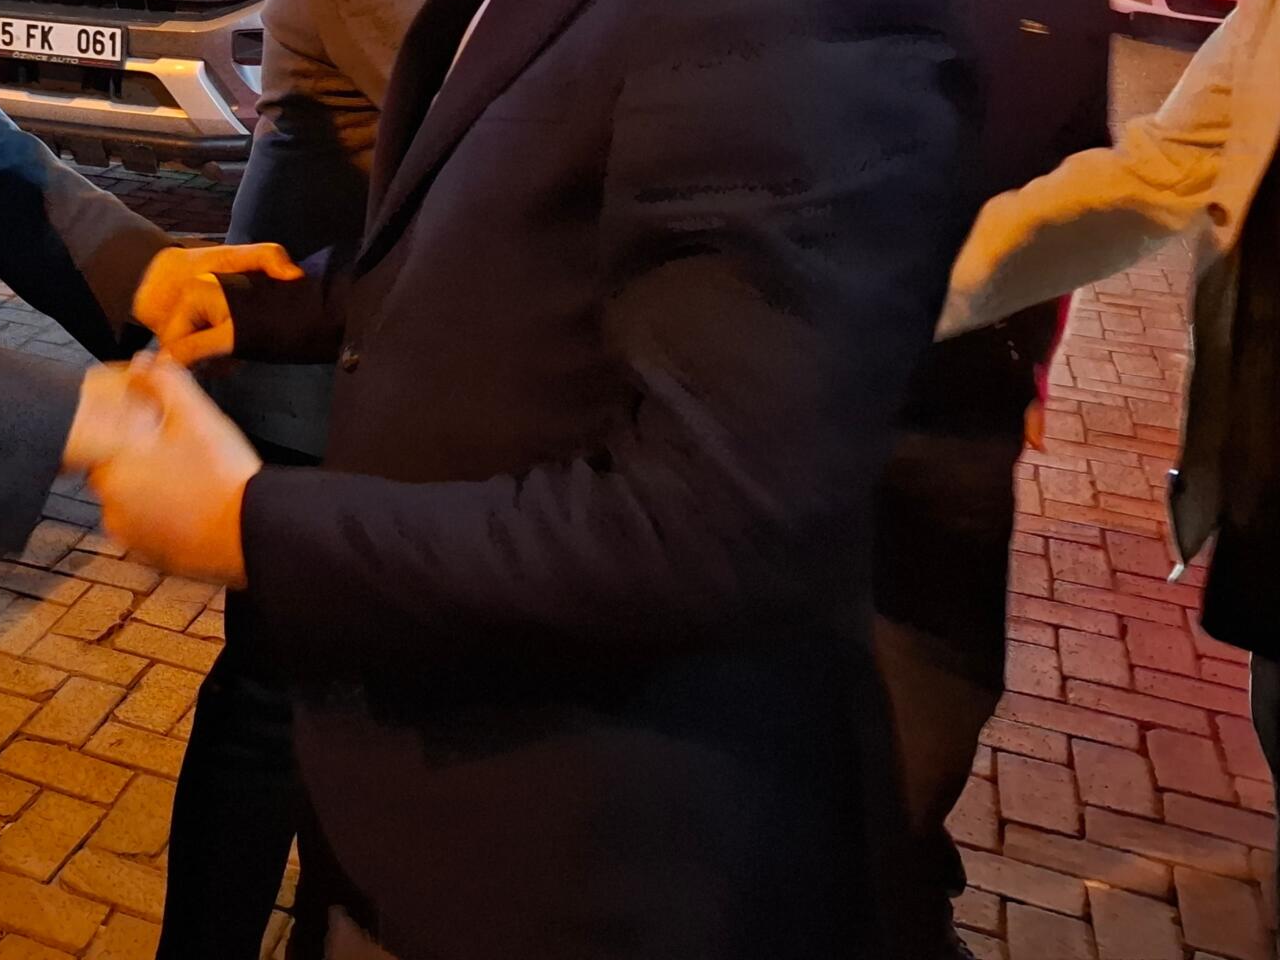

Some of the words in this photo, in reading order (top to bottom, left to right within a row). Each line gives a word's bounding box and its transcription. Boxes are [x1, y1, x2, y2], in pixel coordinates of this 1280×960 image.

[26, 24, 53, 51] FK
[77, 28, 117, 57] 061
[50, 56, 79, 65] AUTO
